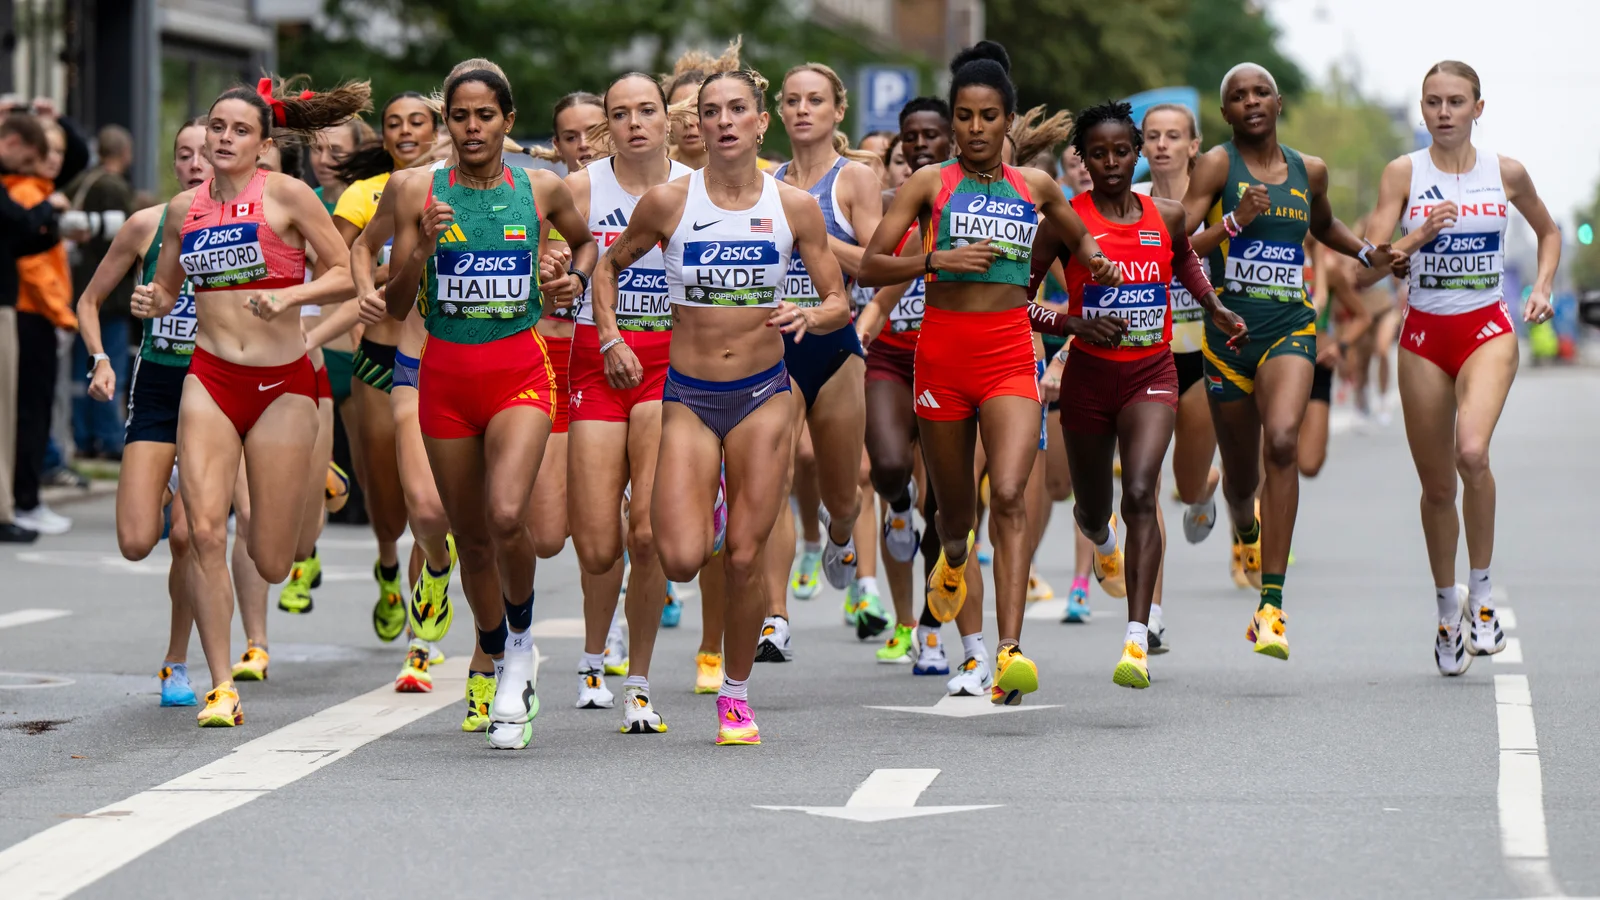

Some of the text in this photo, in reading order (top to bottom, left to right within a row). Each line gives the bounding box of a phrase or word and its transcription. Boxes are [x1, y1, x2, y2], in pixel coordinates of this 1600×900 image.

[874, 70, 906, 118] P
[1275, 206, 1308, 222] AFRICA
[955, 215, 1034, 245] HAYLOM
[183, 245, 258, 272] STAFFORD
[1424, 254, 1495, 274] HAQUET
[206, 267, 265, 284] COPENHAGEN 26
[696, 268, 766, 288] HYDE
[1235, 262, 1297, 285] MORE
[1441, 278, 1490, 286] COPENHAGEN
[447, 278, 523, 299] HAILU
[708, 290, 773, 301] COPENHAGEN 26
[1246, 286, 1293, 297] COPENHAGEN
[461, 305, 518, 314] COPENHAGEN
[1027, 301, 1058, 326] NYA
[617, 319, 670, 329] COPENHAGEN
